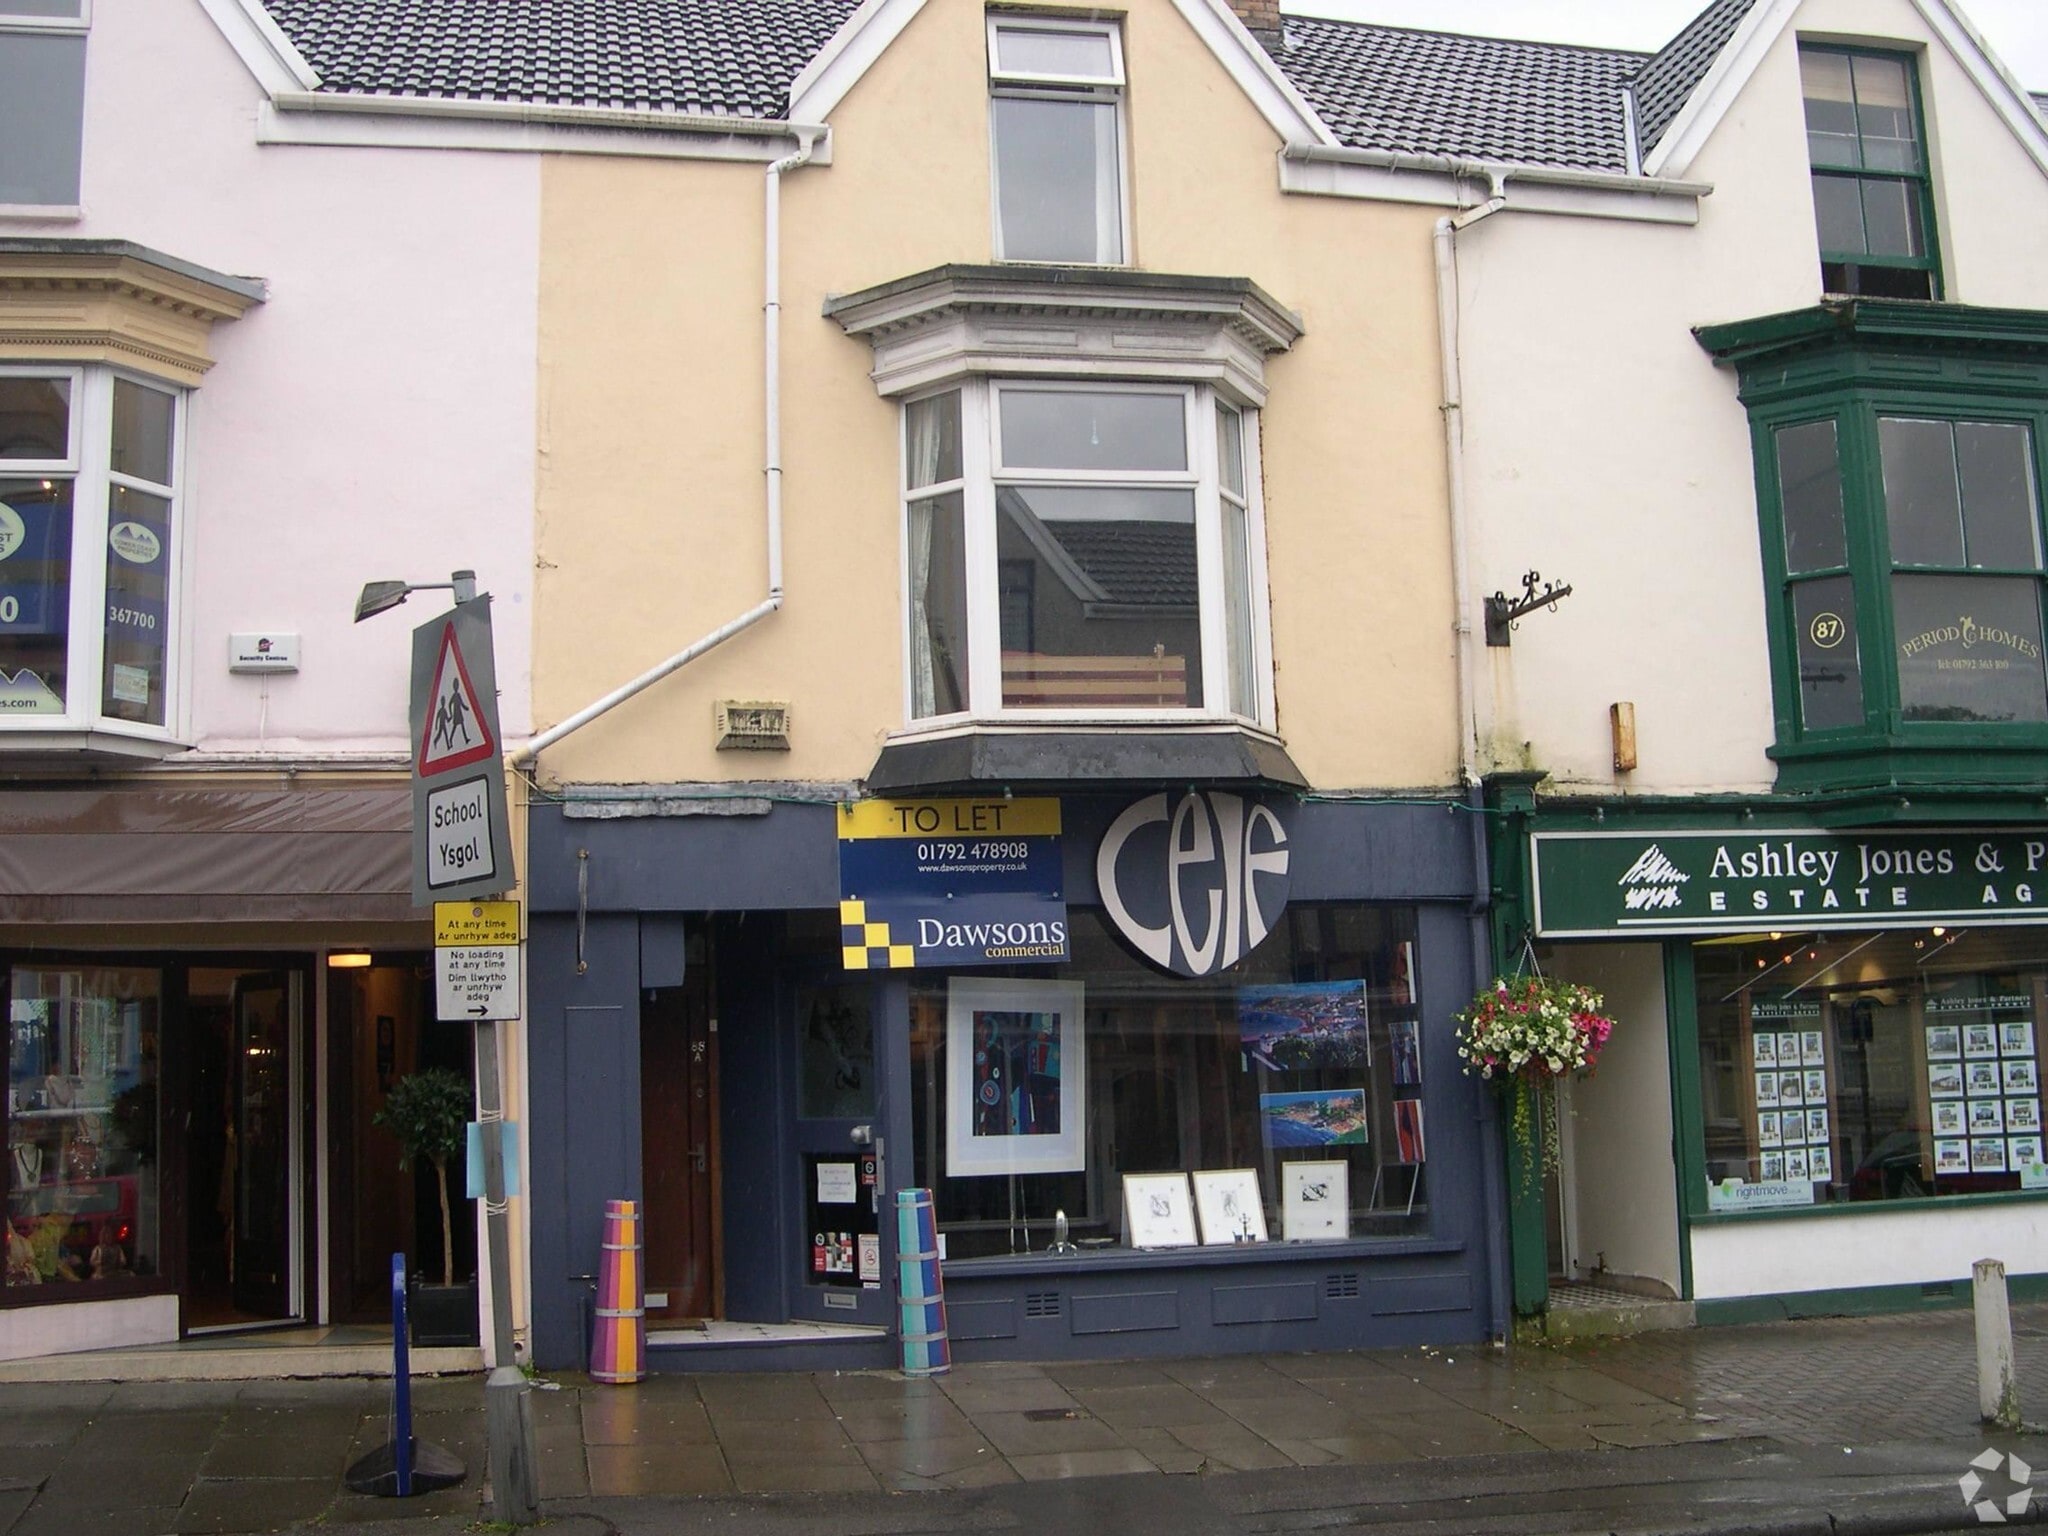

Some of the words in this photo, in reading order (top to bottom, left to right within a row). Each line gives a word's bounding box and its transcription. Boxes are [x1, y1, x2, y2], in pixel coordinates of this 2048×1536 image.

[110, 605, 155, 630] 367700
[1817, 620, 1838, 639] 87
[1902, 626, 1960, 658] PERIOD
[1980, 626, 2039, 658] HOMES
[434, 794, 482, 828] School
[894, 805, 940, 833] TO
[955, 804, 1008, 832] LET
[439, 836, 479, 868] Ysgol
[917, 843, 967, 861] 01792
[971, 842, 1028, 860] 478908
[917, 861, 1028, 874] www.dawsonsproperty.co.uk
[1709, 842, 1839, 887] Ashley
[1857, 844, 1954, 884] Jones
[1974, 842, 2005, 873] &
[1709, 887, 1908, 911] ESTATE
[1982, 883, 2033, 903] AG
[448, 920, 459, 928] At
[463, 920, 481, 929] any
[485, 919, 507, 928] time
[438, 932, 449, 940] Ar
[454, 931, 489, 940] unrhyw
[494, 931, 517, 940] adeg
[917, 918, 1066, 948] Dawsons
[450, 951, 465, 959] No
[469, 951, 504, 960] loading
[985, 943, 1065, 958] commercial
[449, 961, 459, 969] at
[463, 961, 480, 970] any
[485, 960, 506, 968] time
[448, 974, 467, 982] Dim
[471, 973, 507, 982] llwytho
[453, 984, 462, 992] ar
[467, 983, 503, 992] unrhyw
[466, 992, 490, 1002] adeg
[1736, 1184, 1788, 1200] rightmove
